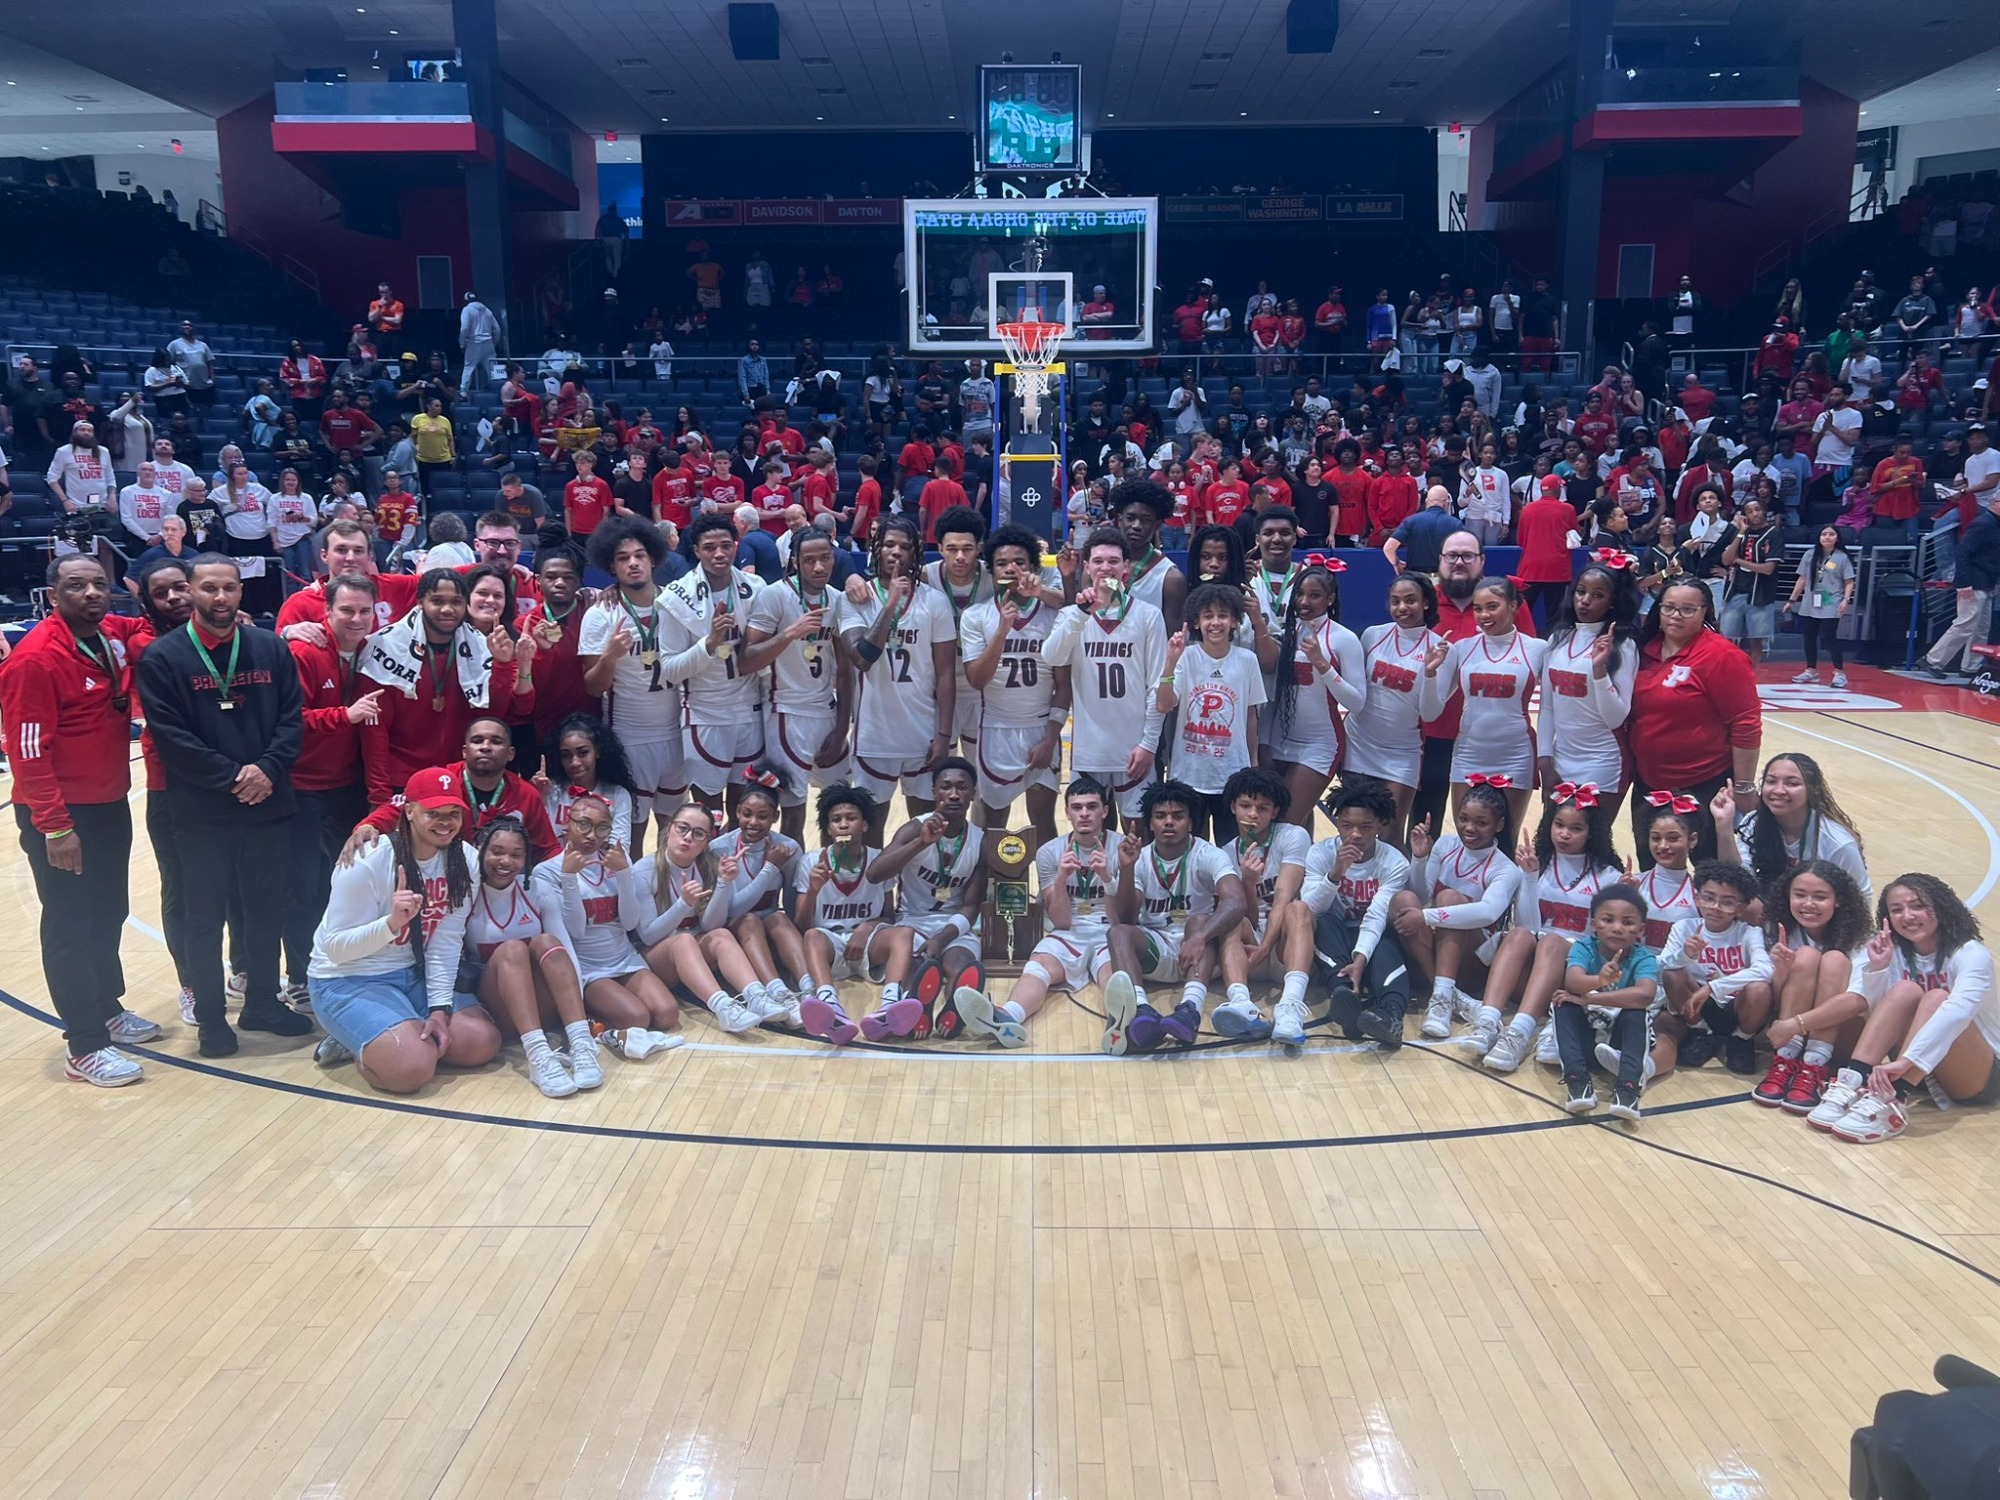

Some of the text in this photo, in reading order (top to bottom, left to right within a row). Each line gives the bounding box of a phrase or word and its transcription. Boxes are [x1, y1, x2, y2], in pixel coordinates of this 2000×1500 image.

[1261, 198, 1305, 208] GEORGE
[1336, 201, 1393, 213] LA SALLE
[752, 206, 813, 217] DAVIDSON
[838, 206, 883, 217] DAYTON
[1248, 208, 1319, 219] WASHINGTON
[134, 494, 160, 502] LEGACY
[137, 509, 160, 518] LOCK
[376, 509, 400, 532] 23
[1084, 641, 1133, 658] VIKINGS
[886, 648, 913, 683] 12
[1002, 657, 1038, 688] 20
[1662, 664, 1692, 688] P
[1096, 662, 1126, 699] 10
[1200, 693, 1224, 719] P
[1185, 742, 1196, 754] 20
[1213, 748, 1225, 758] 25
[822, 902, 872, 920] VIKINGS
